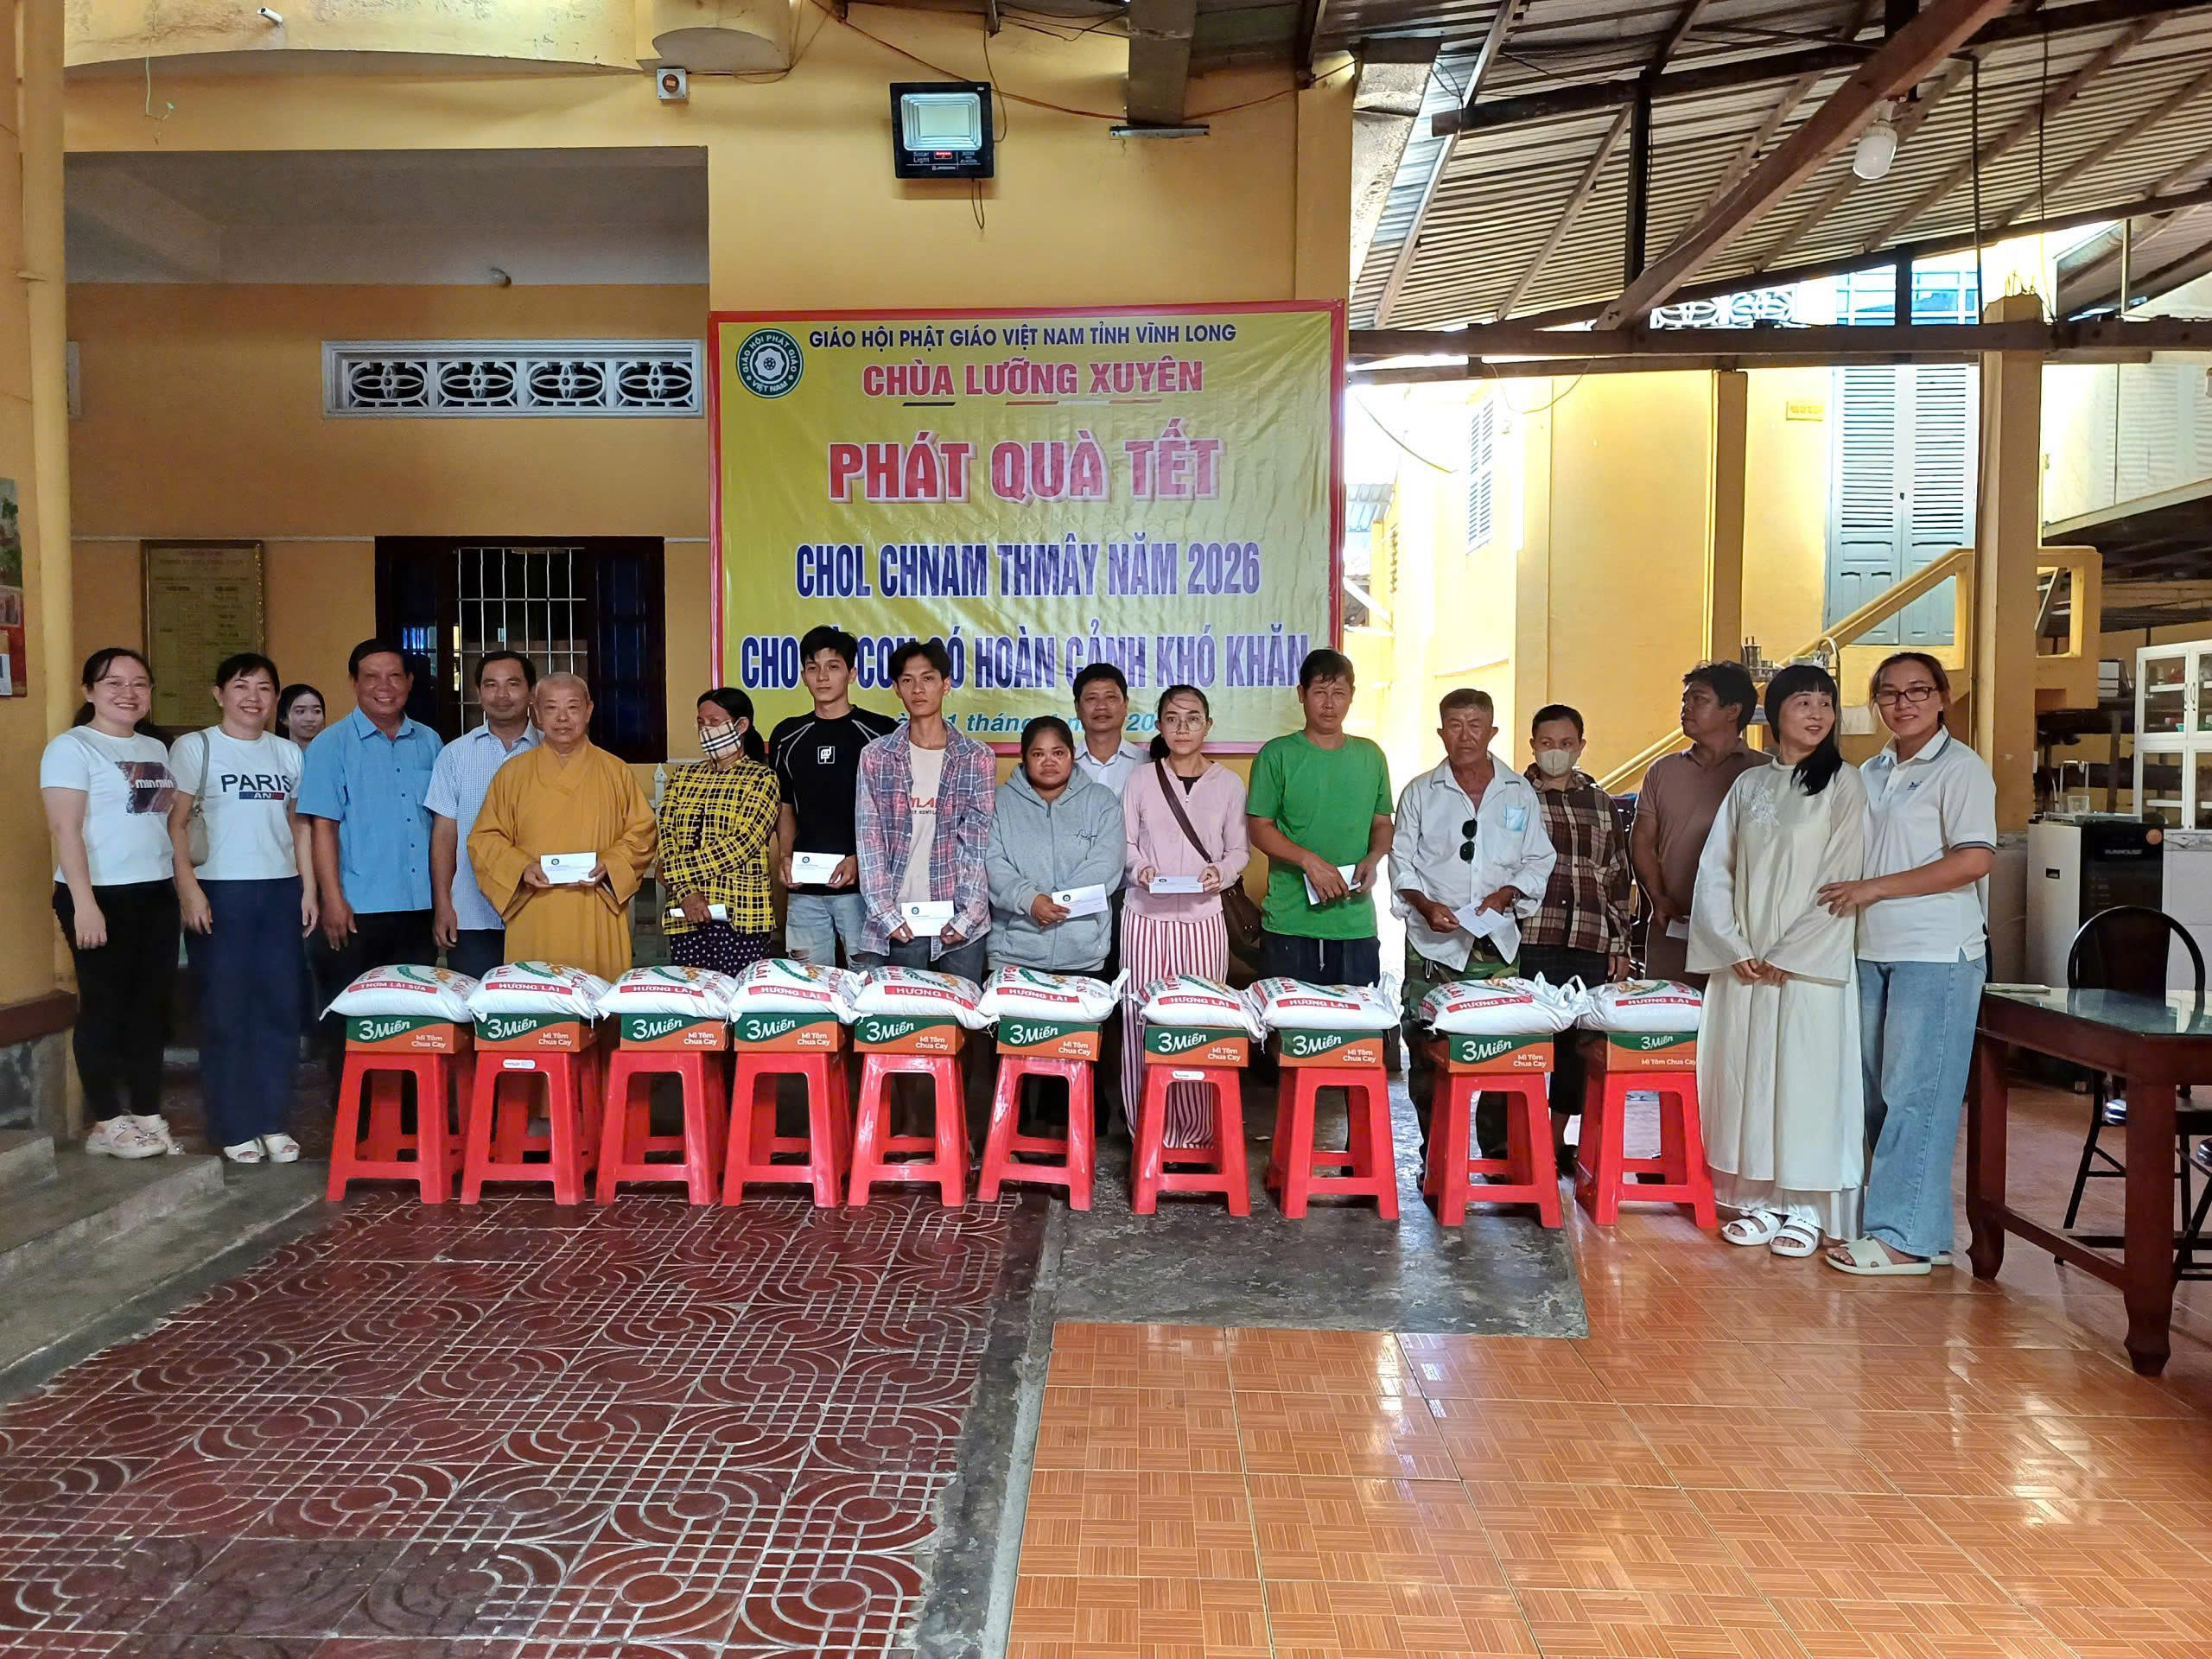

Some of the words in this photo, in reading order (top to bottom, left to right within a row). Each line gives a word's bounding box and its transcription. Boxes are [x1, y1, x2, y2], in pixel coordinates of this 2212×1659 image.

[810, 326, 856, 347] GIÁO
[862, 326, 893, 352] HỘI
[900, 325, 944, 352] PHẬT
[950, 324, 996, 346] GIÁO
[1003, 324, 1038, 351] VIỆT
[1044, 327, 1084, 346] NAM
[1090, 321, 1129, 344] TỈNH
[1136, 322, 1179, 343] VĨNH
[1185, 324, 1236, 343] LONG
[863, 359, 955, 397] CHÙA
[965, 357, 1077, 395] LƯỠNG
[1089, 354, 1204, 394] XUYÊN
[829, 430, 974, 501] PHÁT
[990, 429, 1107, 505] QUÀ
[1124, 418, 1222, 499] TẾT
[797, 544, 871, 597] CHOL
[880, 544, 987, 597] CHNAM
[997, 533, 1099, 596] THMÂY
[1109, 532, 1178, 595] NĂM
[1187, 543, 1261, 594] 2026
[741, 636, 799, 689] CHO
[857, 636, 918, 689] CO
[975, 626, 1055, 688] HOÀN
[1157, 624, 1216, 688] KHÓ
[1226, 623, 1308, 687] KHĂN
[220, 774, 291, 793] PARIS
